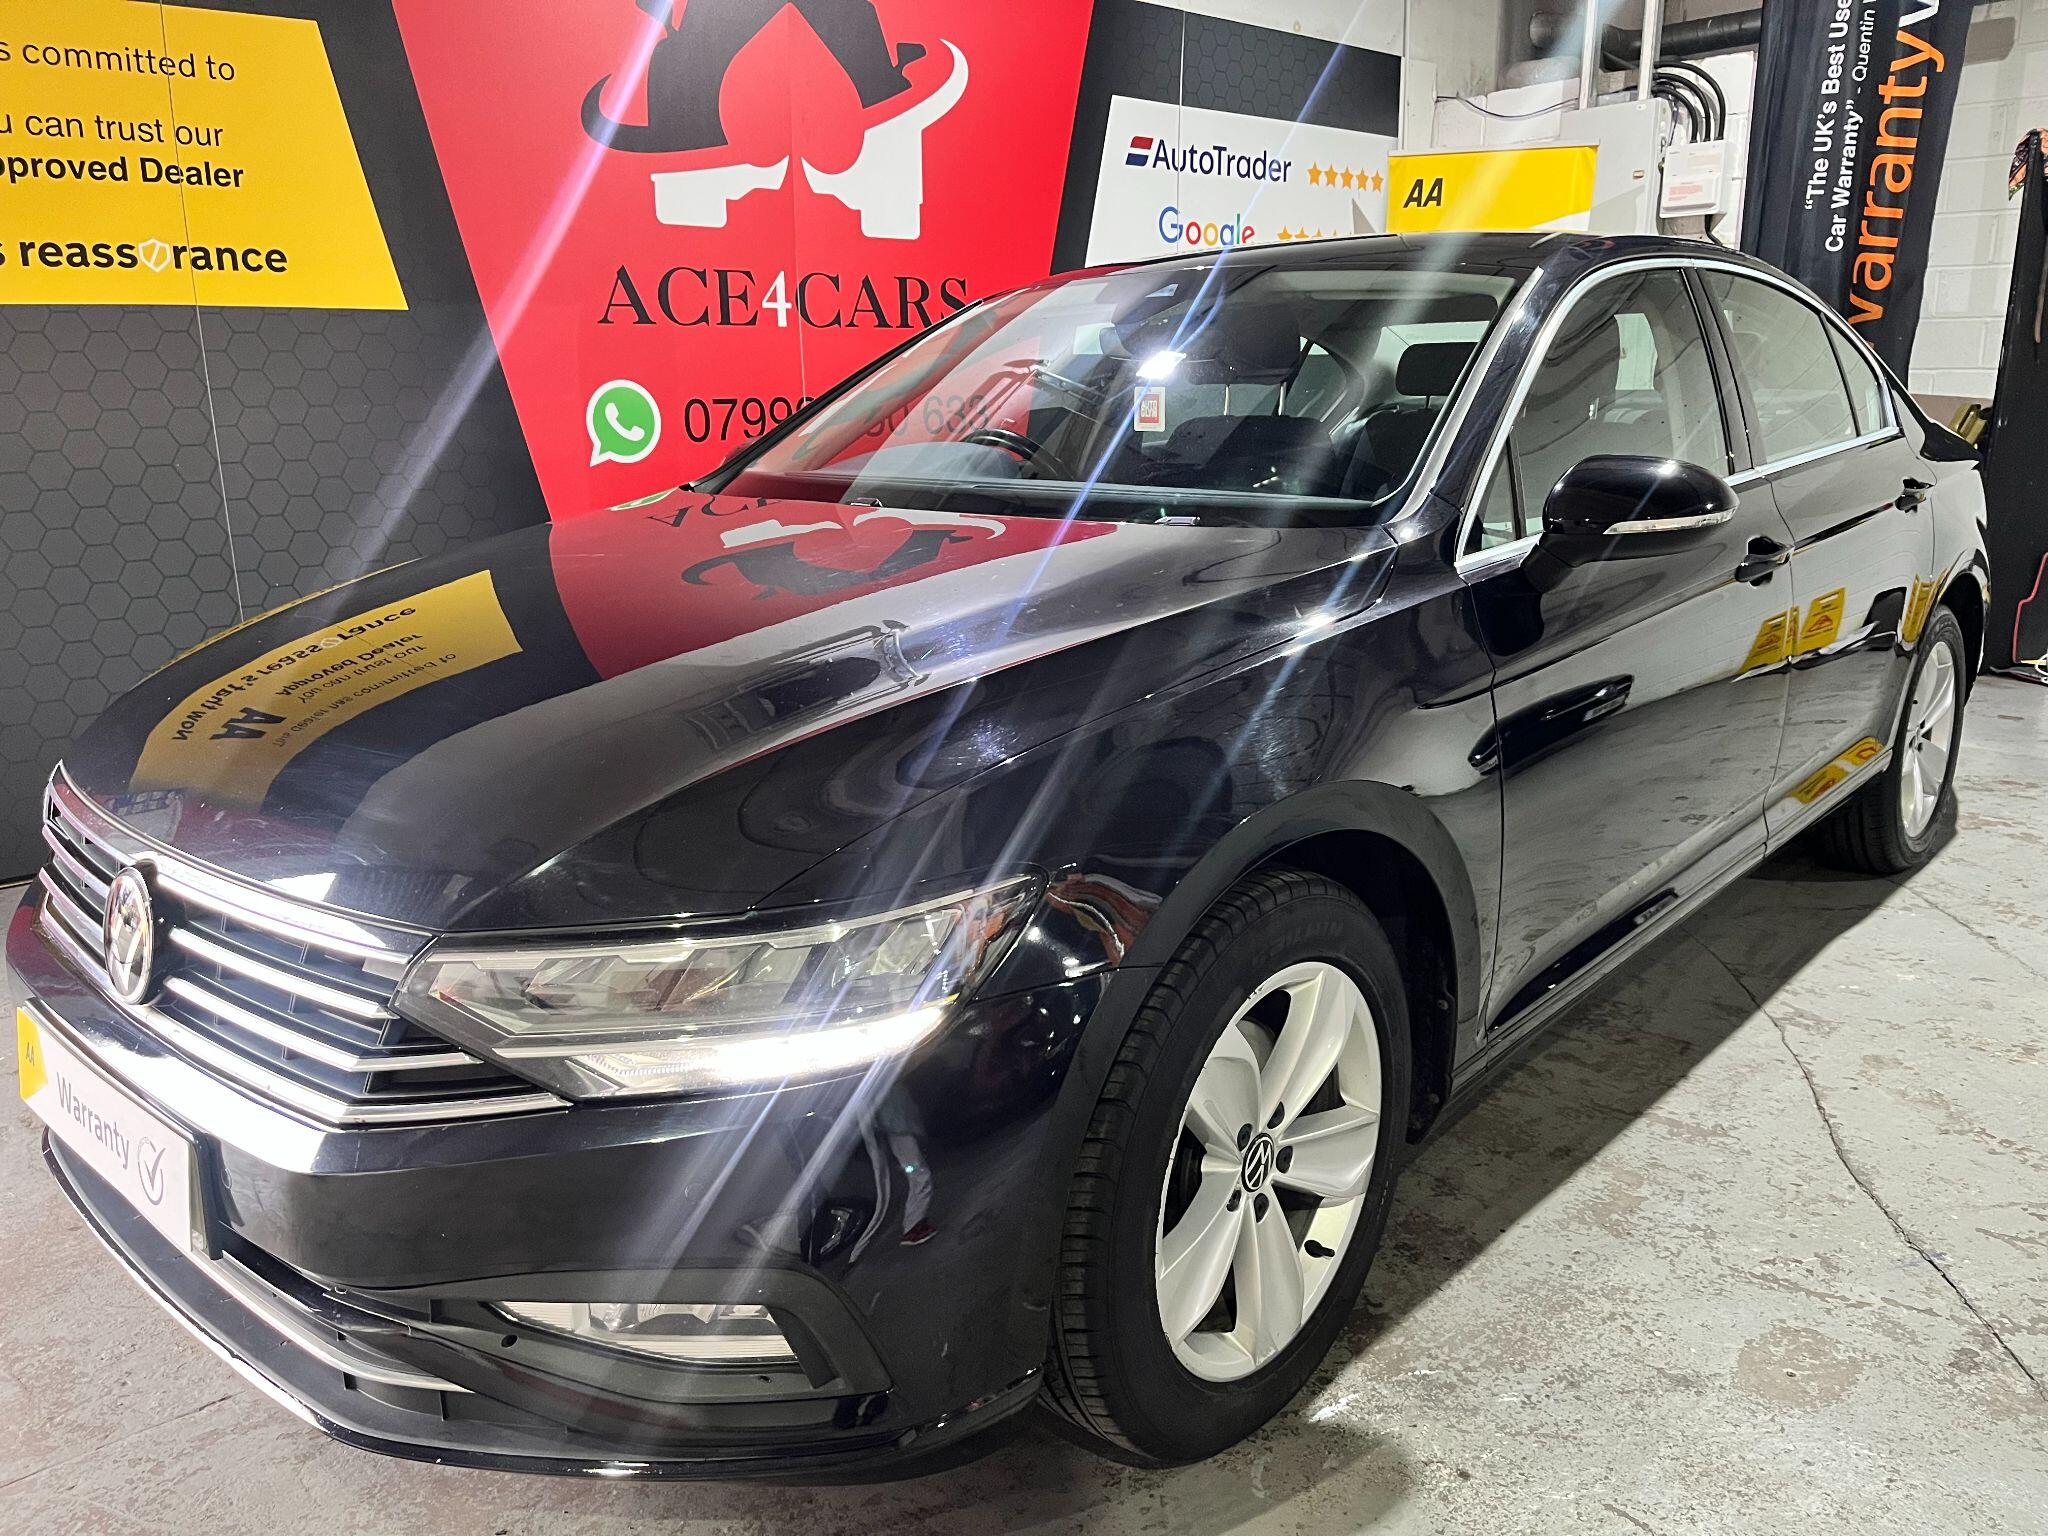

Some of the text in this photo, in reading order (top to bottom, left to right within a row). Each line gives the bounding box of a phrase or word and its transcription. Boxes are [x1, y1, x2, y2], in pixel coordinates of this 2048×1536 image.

[22, 43, 196, 78] committed
[205, 55, 236, 81] to
[1852, 9, 1876, 80] Quentin
[1821, 57, 1845, 96] Best
[25, 115, 84, 138] can
[94, 114, 165, 144] trust
[175, 125, 224, 147] our
[1812, 101, 1838, 153] UK’s
[0, 154, 245, 189] proved Dealer
[1152, 138, 1293, 184] AutoTrader
[1830, 99, 1864, 211] Warranty”
[1403, 177, 1443, 209] AA
[1804, 154, 1831, 211] “The
[1158, 206, 1256, 246] Google
[1824, 213, 1847, 252] Car
[597, 264, 967, 329] ACE4CARS
[25, 1042, 36, 1068] AA
[56, 1071, 130, 1170] Warranty
